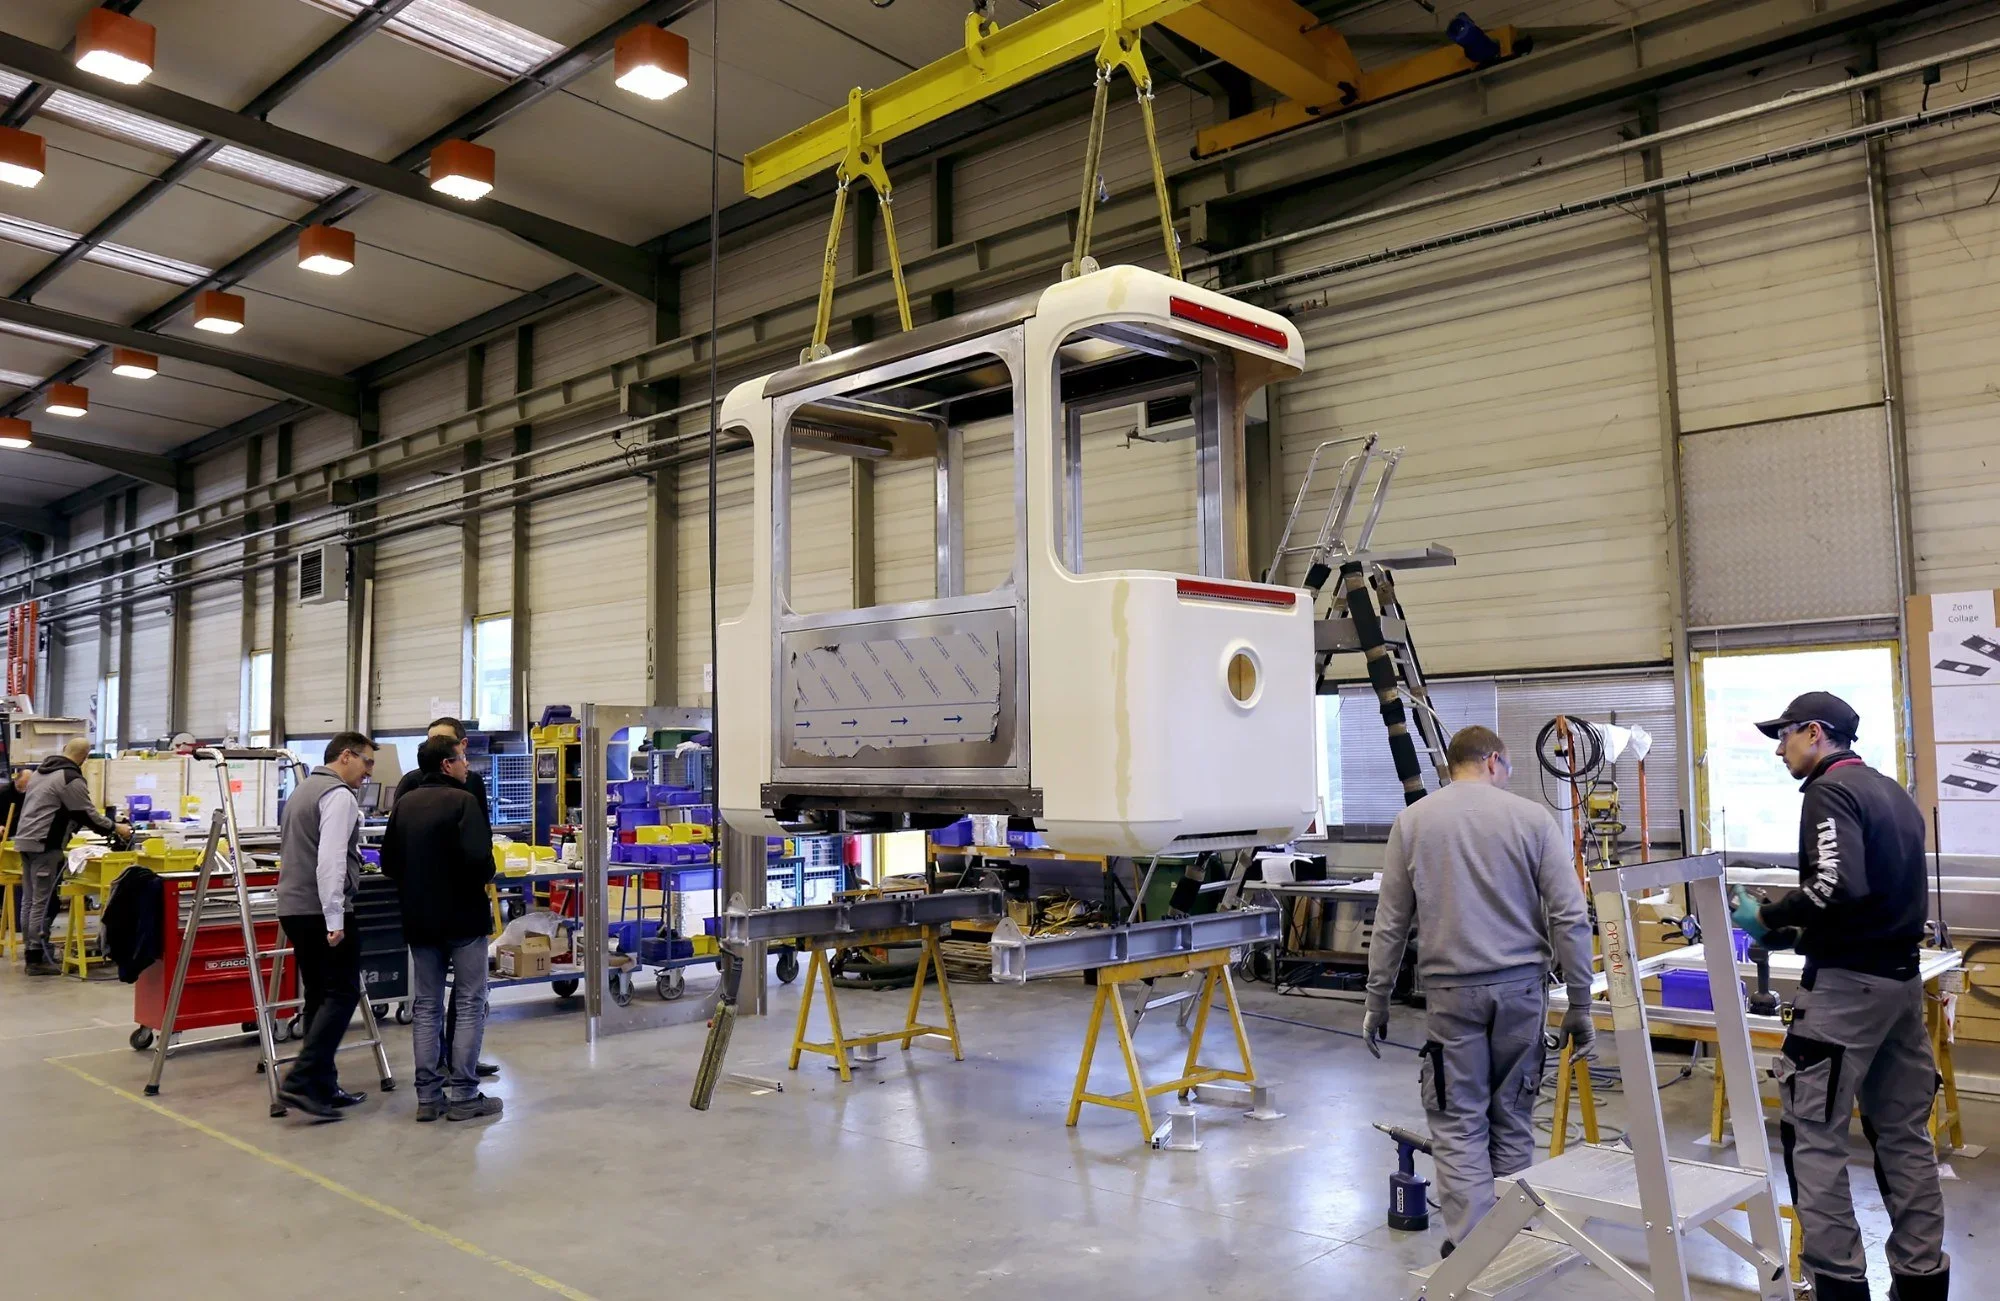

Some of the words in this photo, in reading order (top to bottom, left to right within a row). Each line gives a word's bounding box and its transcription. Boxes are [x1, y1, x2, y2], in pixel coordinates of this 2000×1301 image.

[1952, 603, 1974, 612] Zone
[1948, 615, 1979, 623] Collage
[1605, 921, 1627, 976] OPTION
[220, 959, 249, 968] FACO
